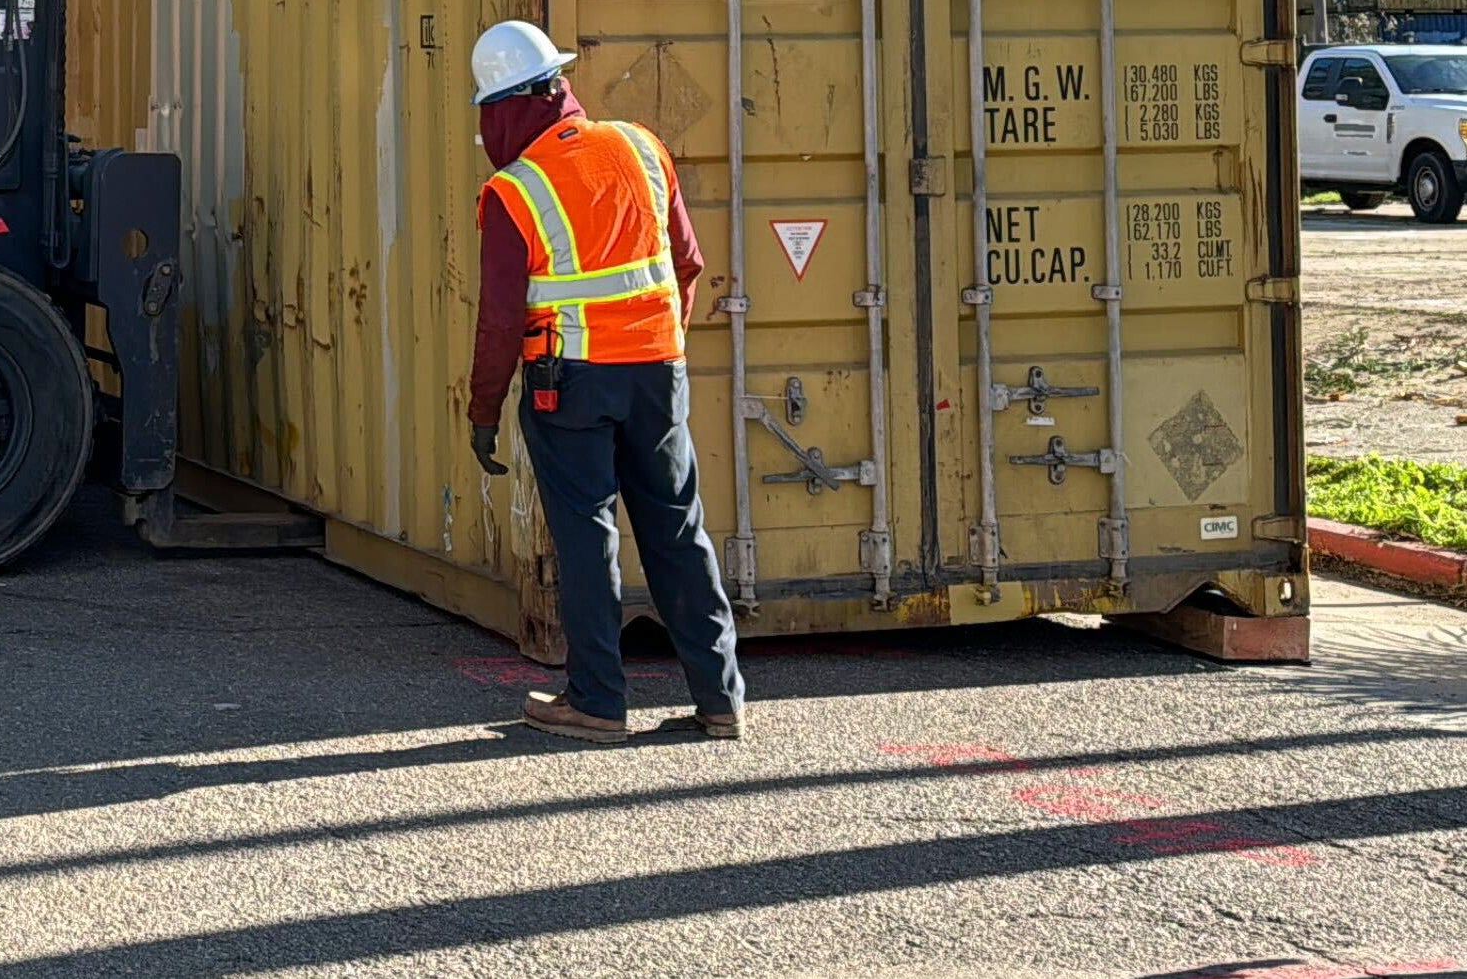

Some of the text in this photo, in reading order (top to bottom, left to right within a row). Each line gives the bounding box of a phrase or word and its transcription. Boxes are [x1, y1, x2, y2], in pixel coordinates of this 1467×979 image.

[1193, 63, 1219, 82] KGS
[1194, 82, 1220, 101] LBS
[985, 106, 1057, 144] TARE
[1195, 102, 1221, 122] KGS
[1196, 121, 1221, 140] LBS
[986, 205, 1040, 244] NET
[1196, 201, 1222, 220] KGS
[1197, 220, 1223, 239] LBS
[1151, 241, 1182, 261] 33.2
[1203, 521, 1235, 533] CIMC
